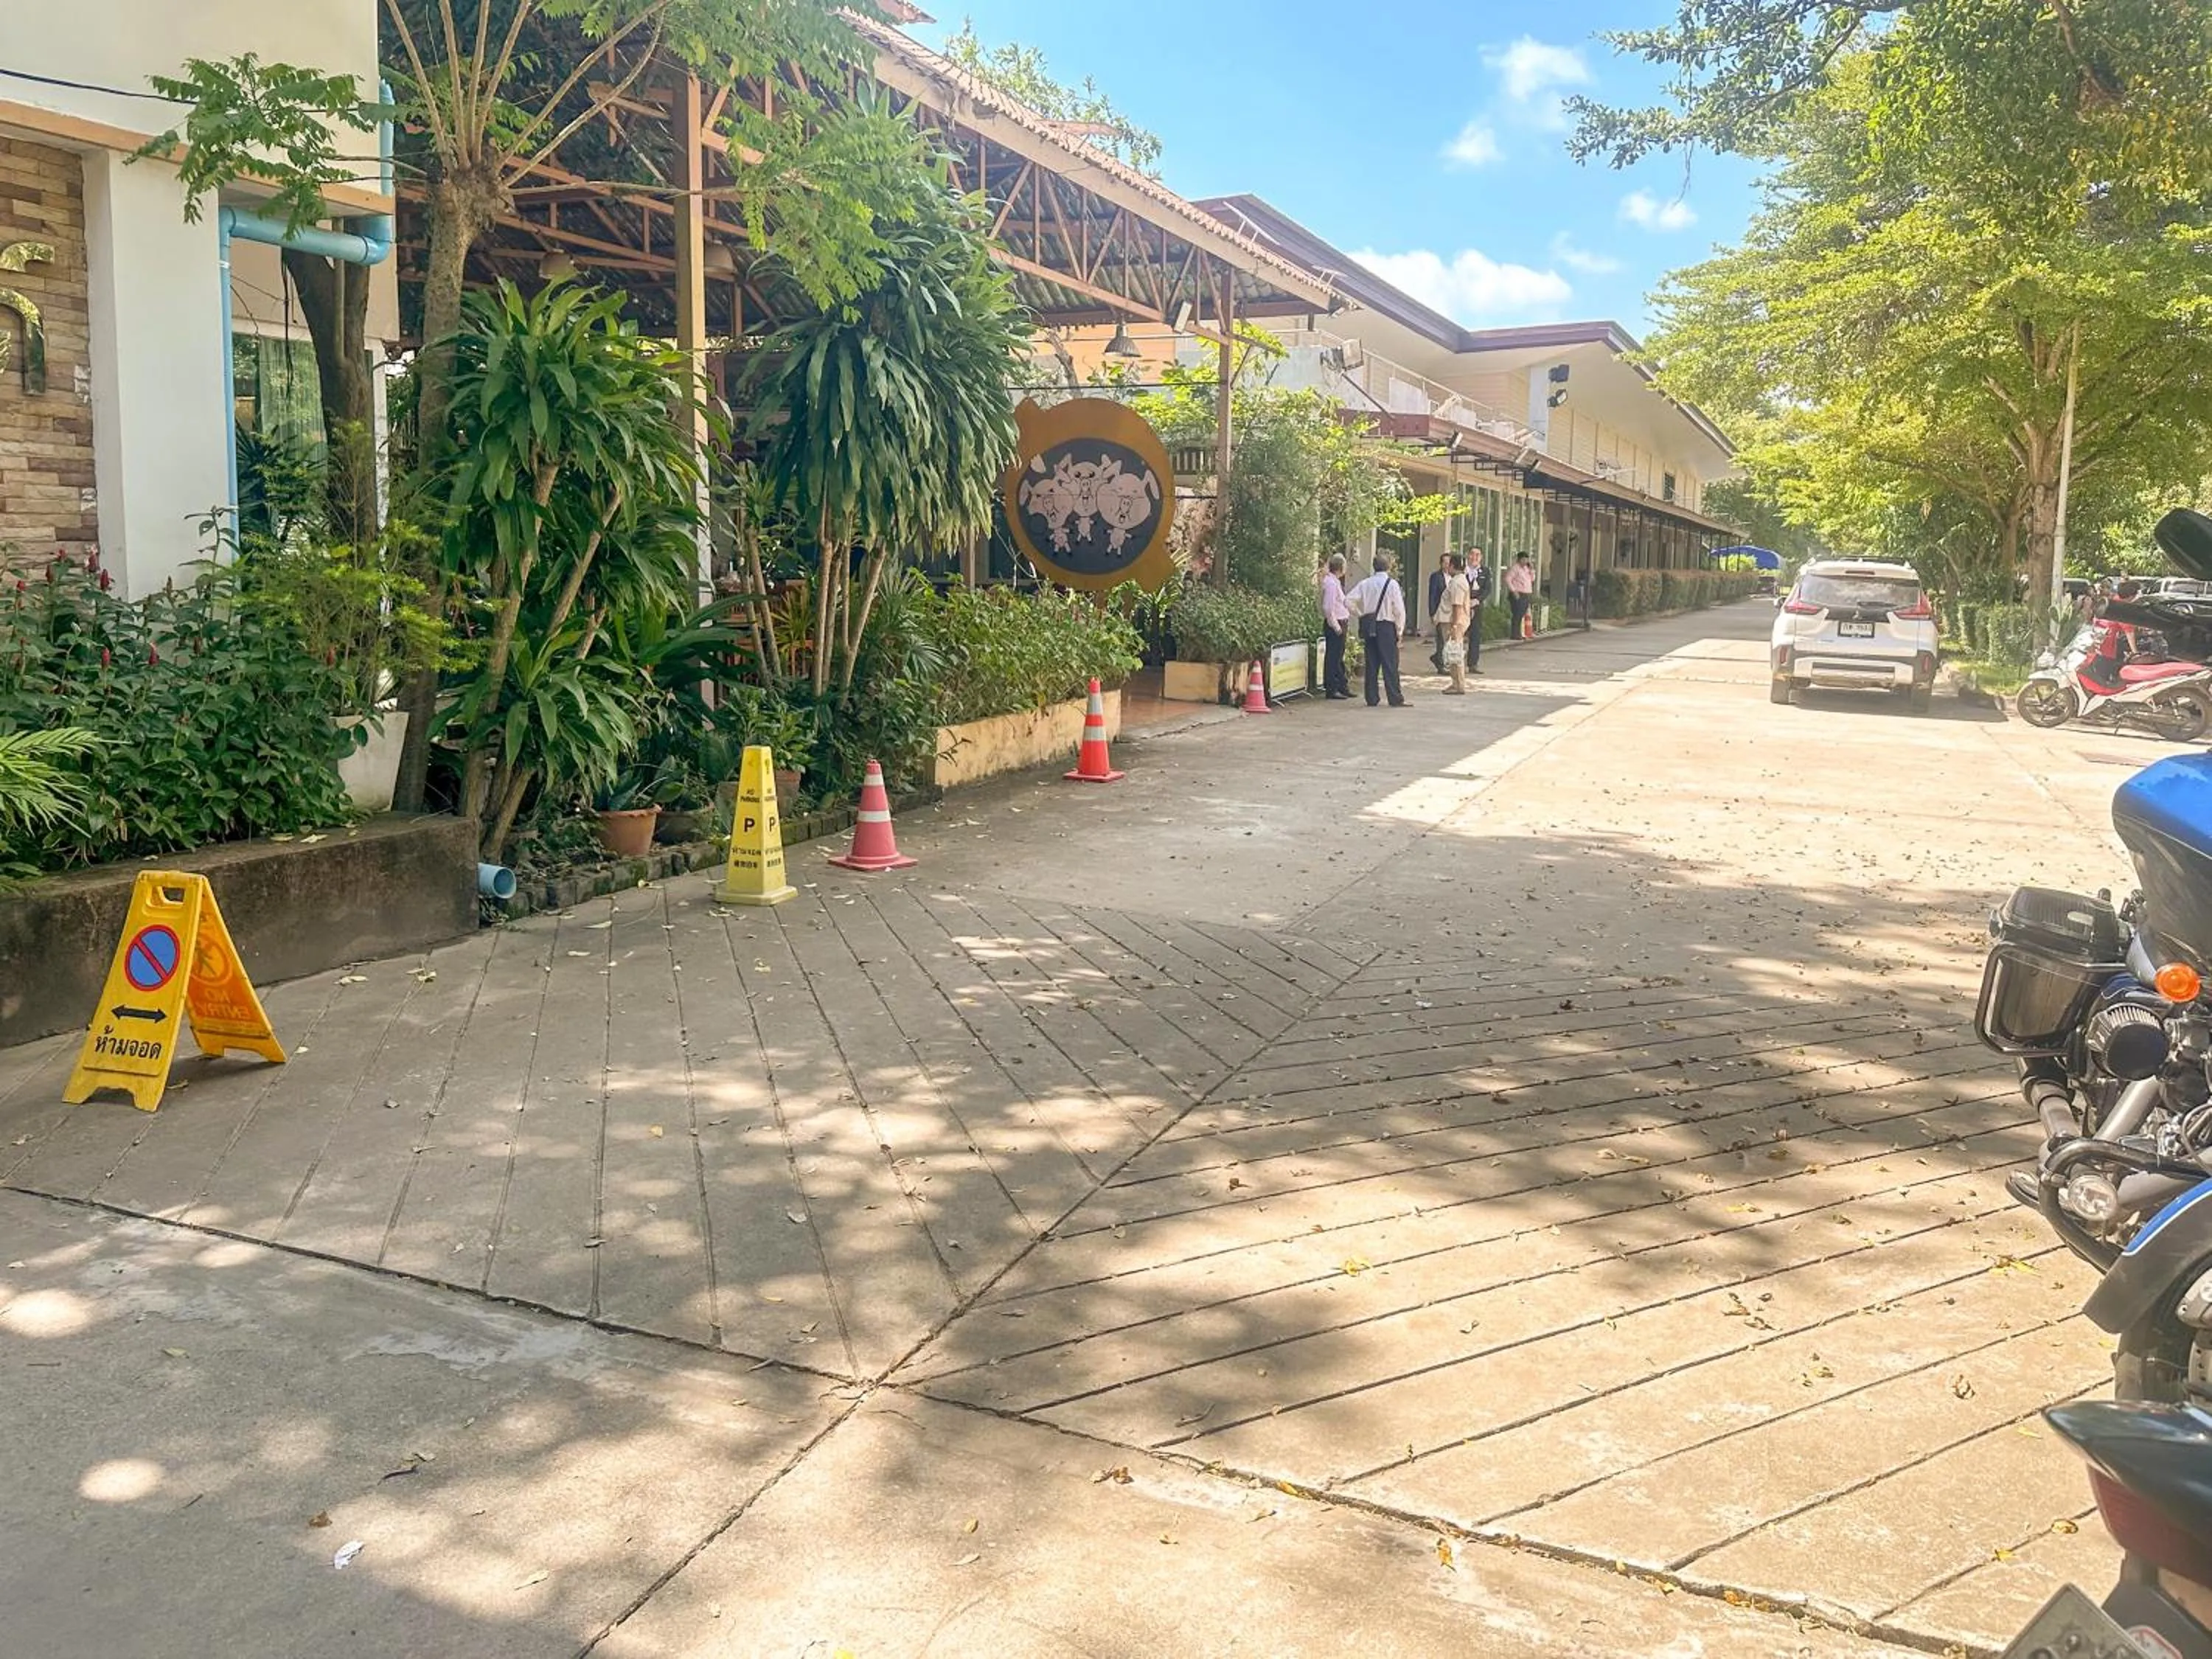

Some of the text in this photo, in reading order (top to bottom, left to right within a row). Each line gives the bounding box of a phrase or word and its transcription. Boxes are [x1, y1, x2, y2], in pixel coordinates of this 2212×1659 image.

[744, 818, 755, 832] P
[769, 817, 776, 832] P
[94, 1024, 161, 1060] ห้ามจอด
